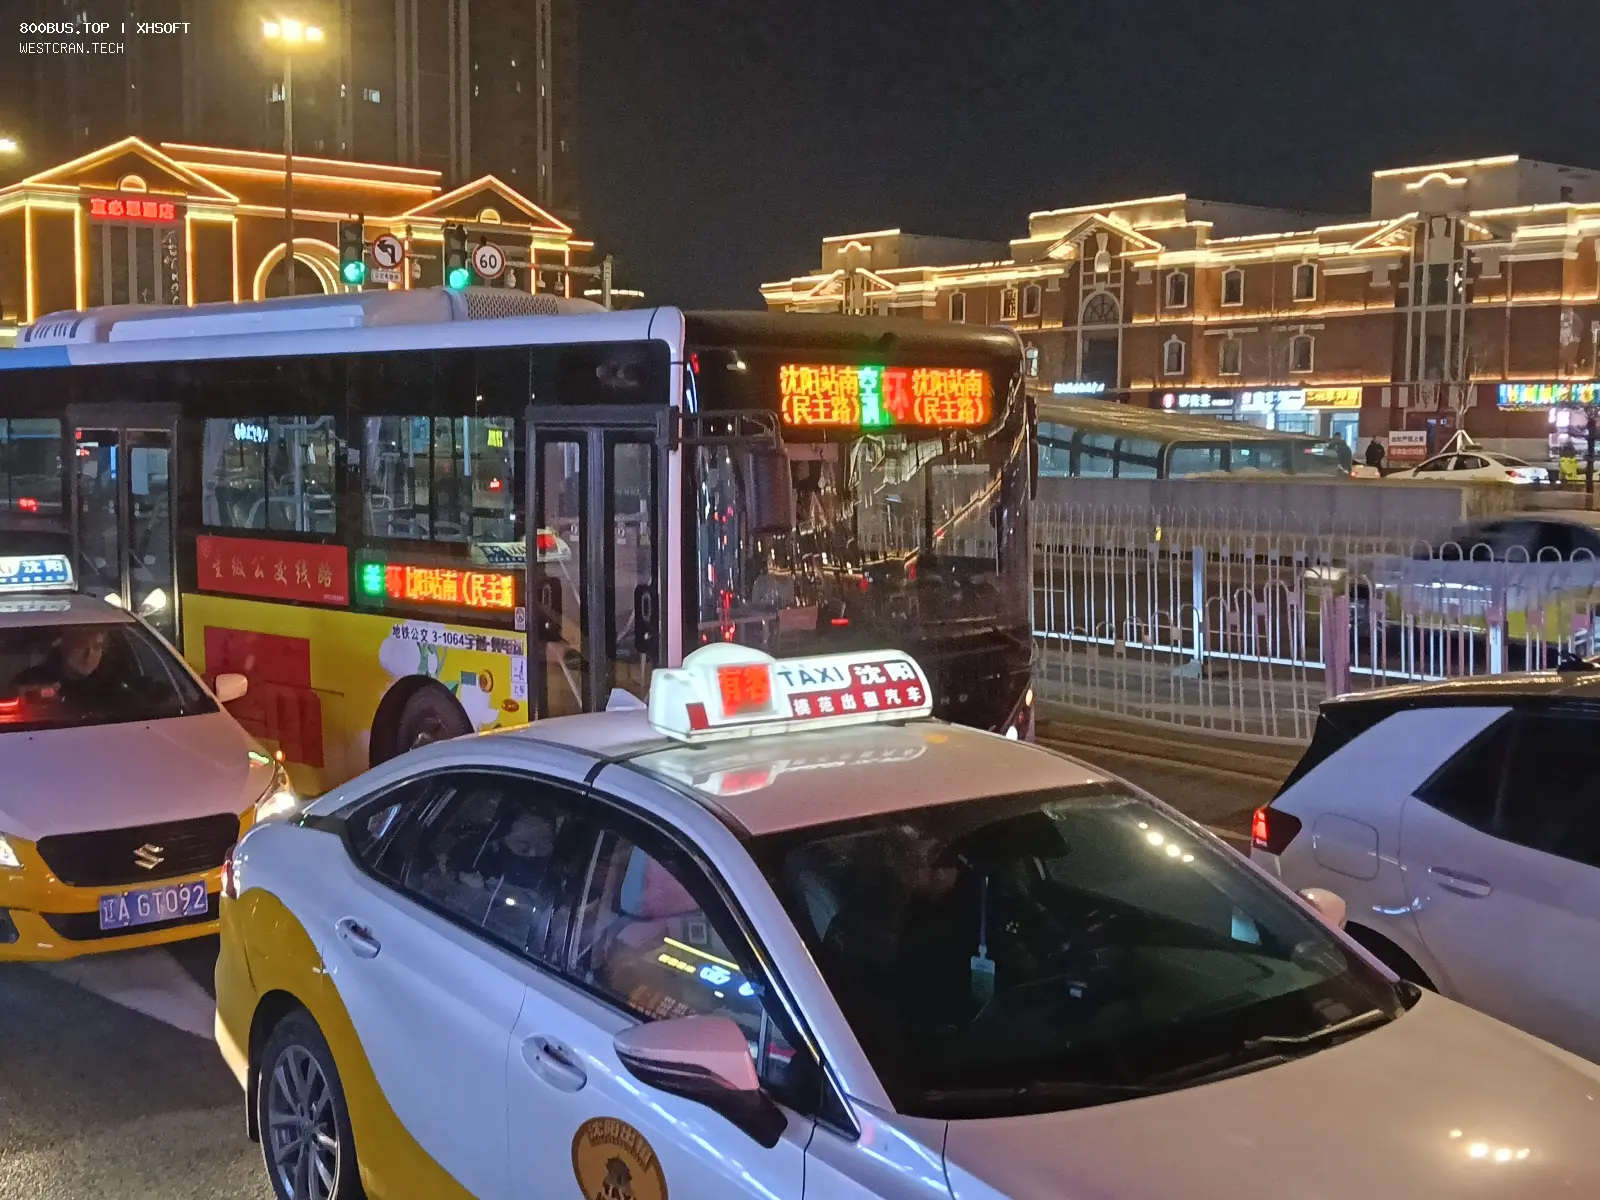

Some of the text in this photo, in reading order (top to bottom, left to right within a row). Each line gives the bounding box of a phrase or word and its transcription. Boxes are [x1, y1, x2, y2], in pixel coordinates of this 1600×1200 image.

[479, 254, 498, 269] 60
[780, 364, 859, 397] 沈阳站南
[912, 367, 983, 397] 沈阳站南
[780, 395, 860, 425] (民主路)
[913, 397, 984, 425] (民主路)
[392, 624, 428, 642] 地铁公交
[432, 630, 464, 646] 3-1064
[777, 661, 916, 687] TAXI 沈阳
[793, 685, 922, 716] 模范出租汽车
[104, 885, 205, 922] 辽A GT092
